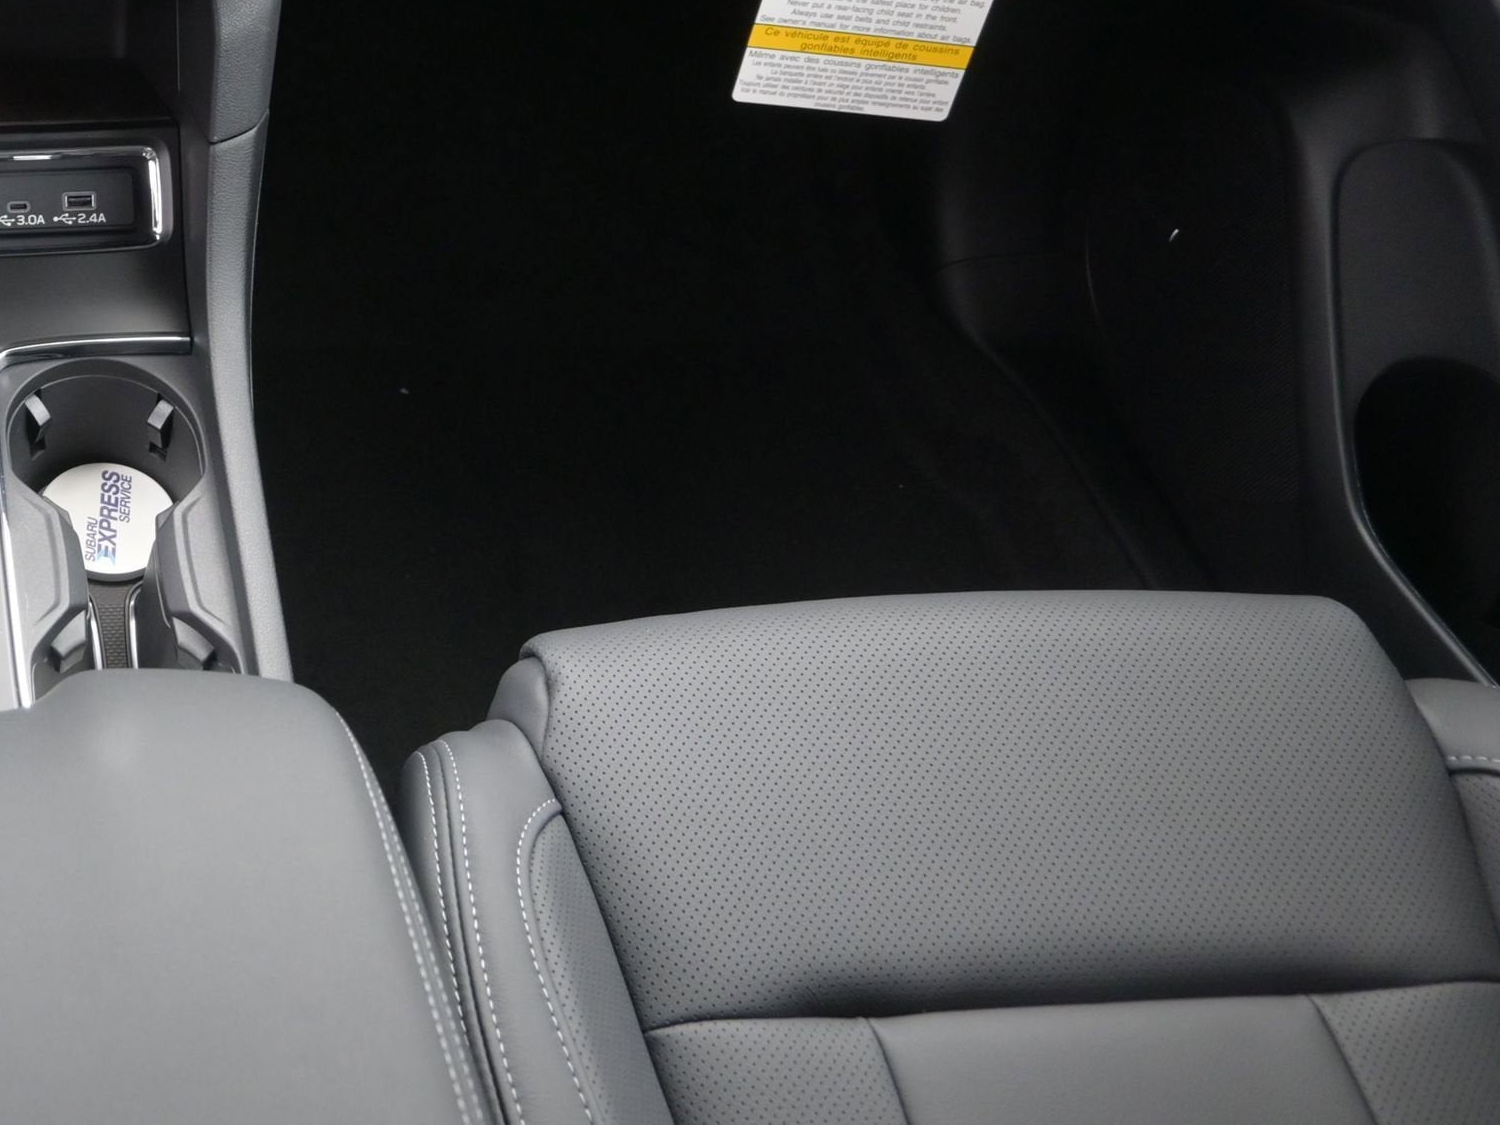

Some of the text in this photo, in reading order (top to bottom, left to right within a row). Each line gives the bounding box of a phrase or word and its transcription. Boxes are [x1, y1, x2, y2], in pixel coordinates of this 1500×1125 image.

[791, 8, 817, 18] Always
[764, 27, 780, 36] Ce
[784, 28, 829, 41] véhicule
[833, 33, 850, 43] est
[895, 40, 908, 50] de
[912, 43, 960, 55] coussins
[800, 42, 917, 61] gonflables intelligents
[779, 54, 801, 62] avec
[804, 56, 820, 64] des
[823, 59, 861, 68] coussins
[912, 66, 959, 79] intelligents
[16, 214, 45, 225] 3.0A
[77, 213, 106, 224] 2.4A
[119, 474, 132, 523] SERVICE
[97, 470, 120, 563] EXPRESS
[84, 516, 98, 562] SUBARU
